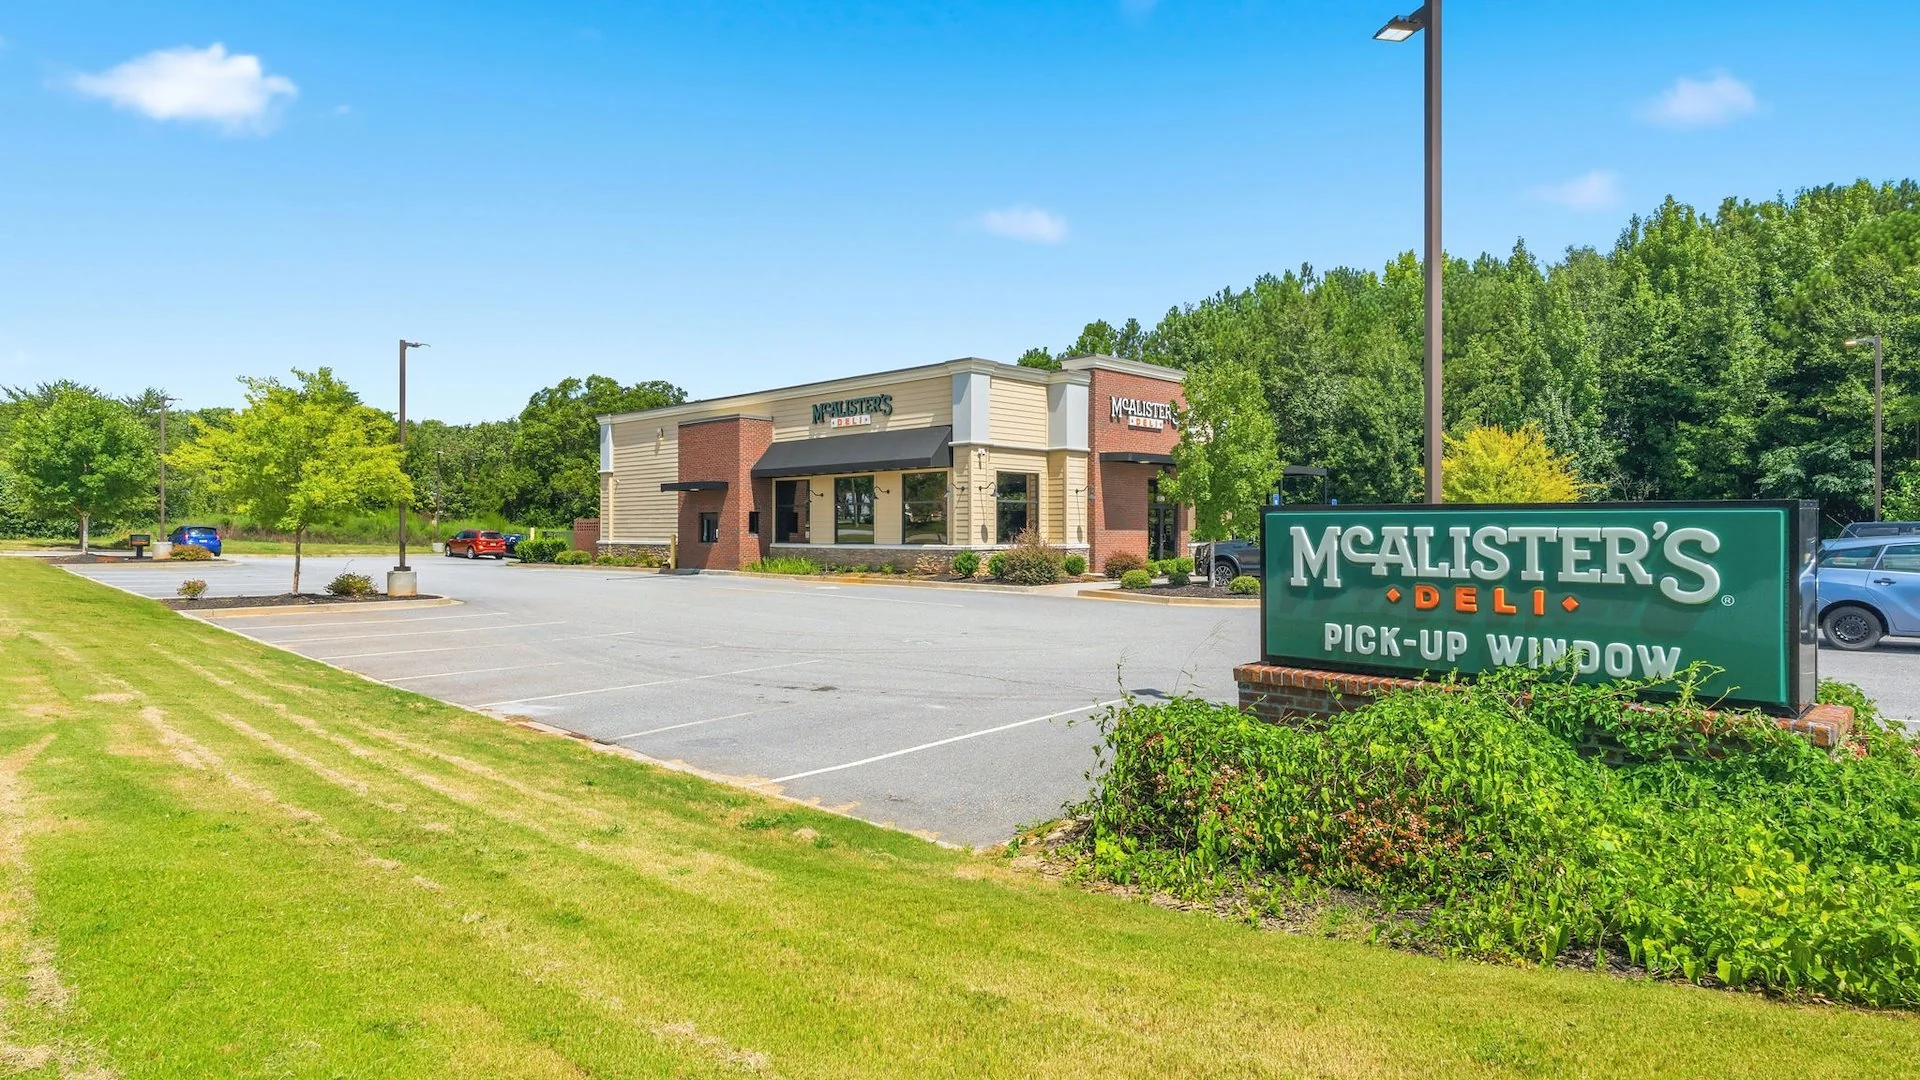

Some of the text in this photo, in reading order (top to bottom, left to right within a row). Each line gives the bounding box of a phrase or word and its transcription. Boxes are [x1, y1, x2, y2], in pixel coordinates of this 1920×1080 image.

[837, 417, 863, 426] DELI
[1110, 396, 1180, 425] McALISTER
[1136, 417, 1158, 428] DELI
[1414, 584, 1545, 616] DELI
[1324, 622, 1681, 679] PICK-UP WINDOW
